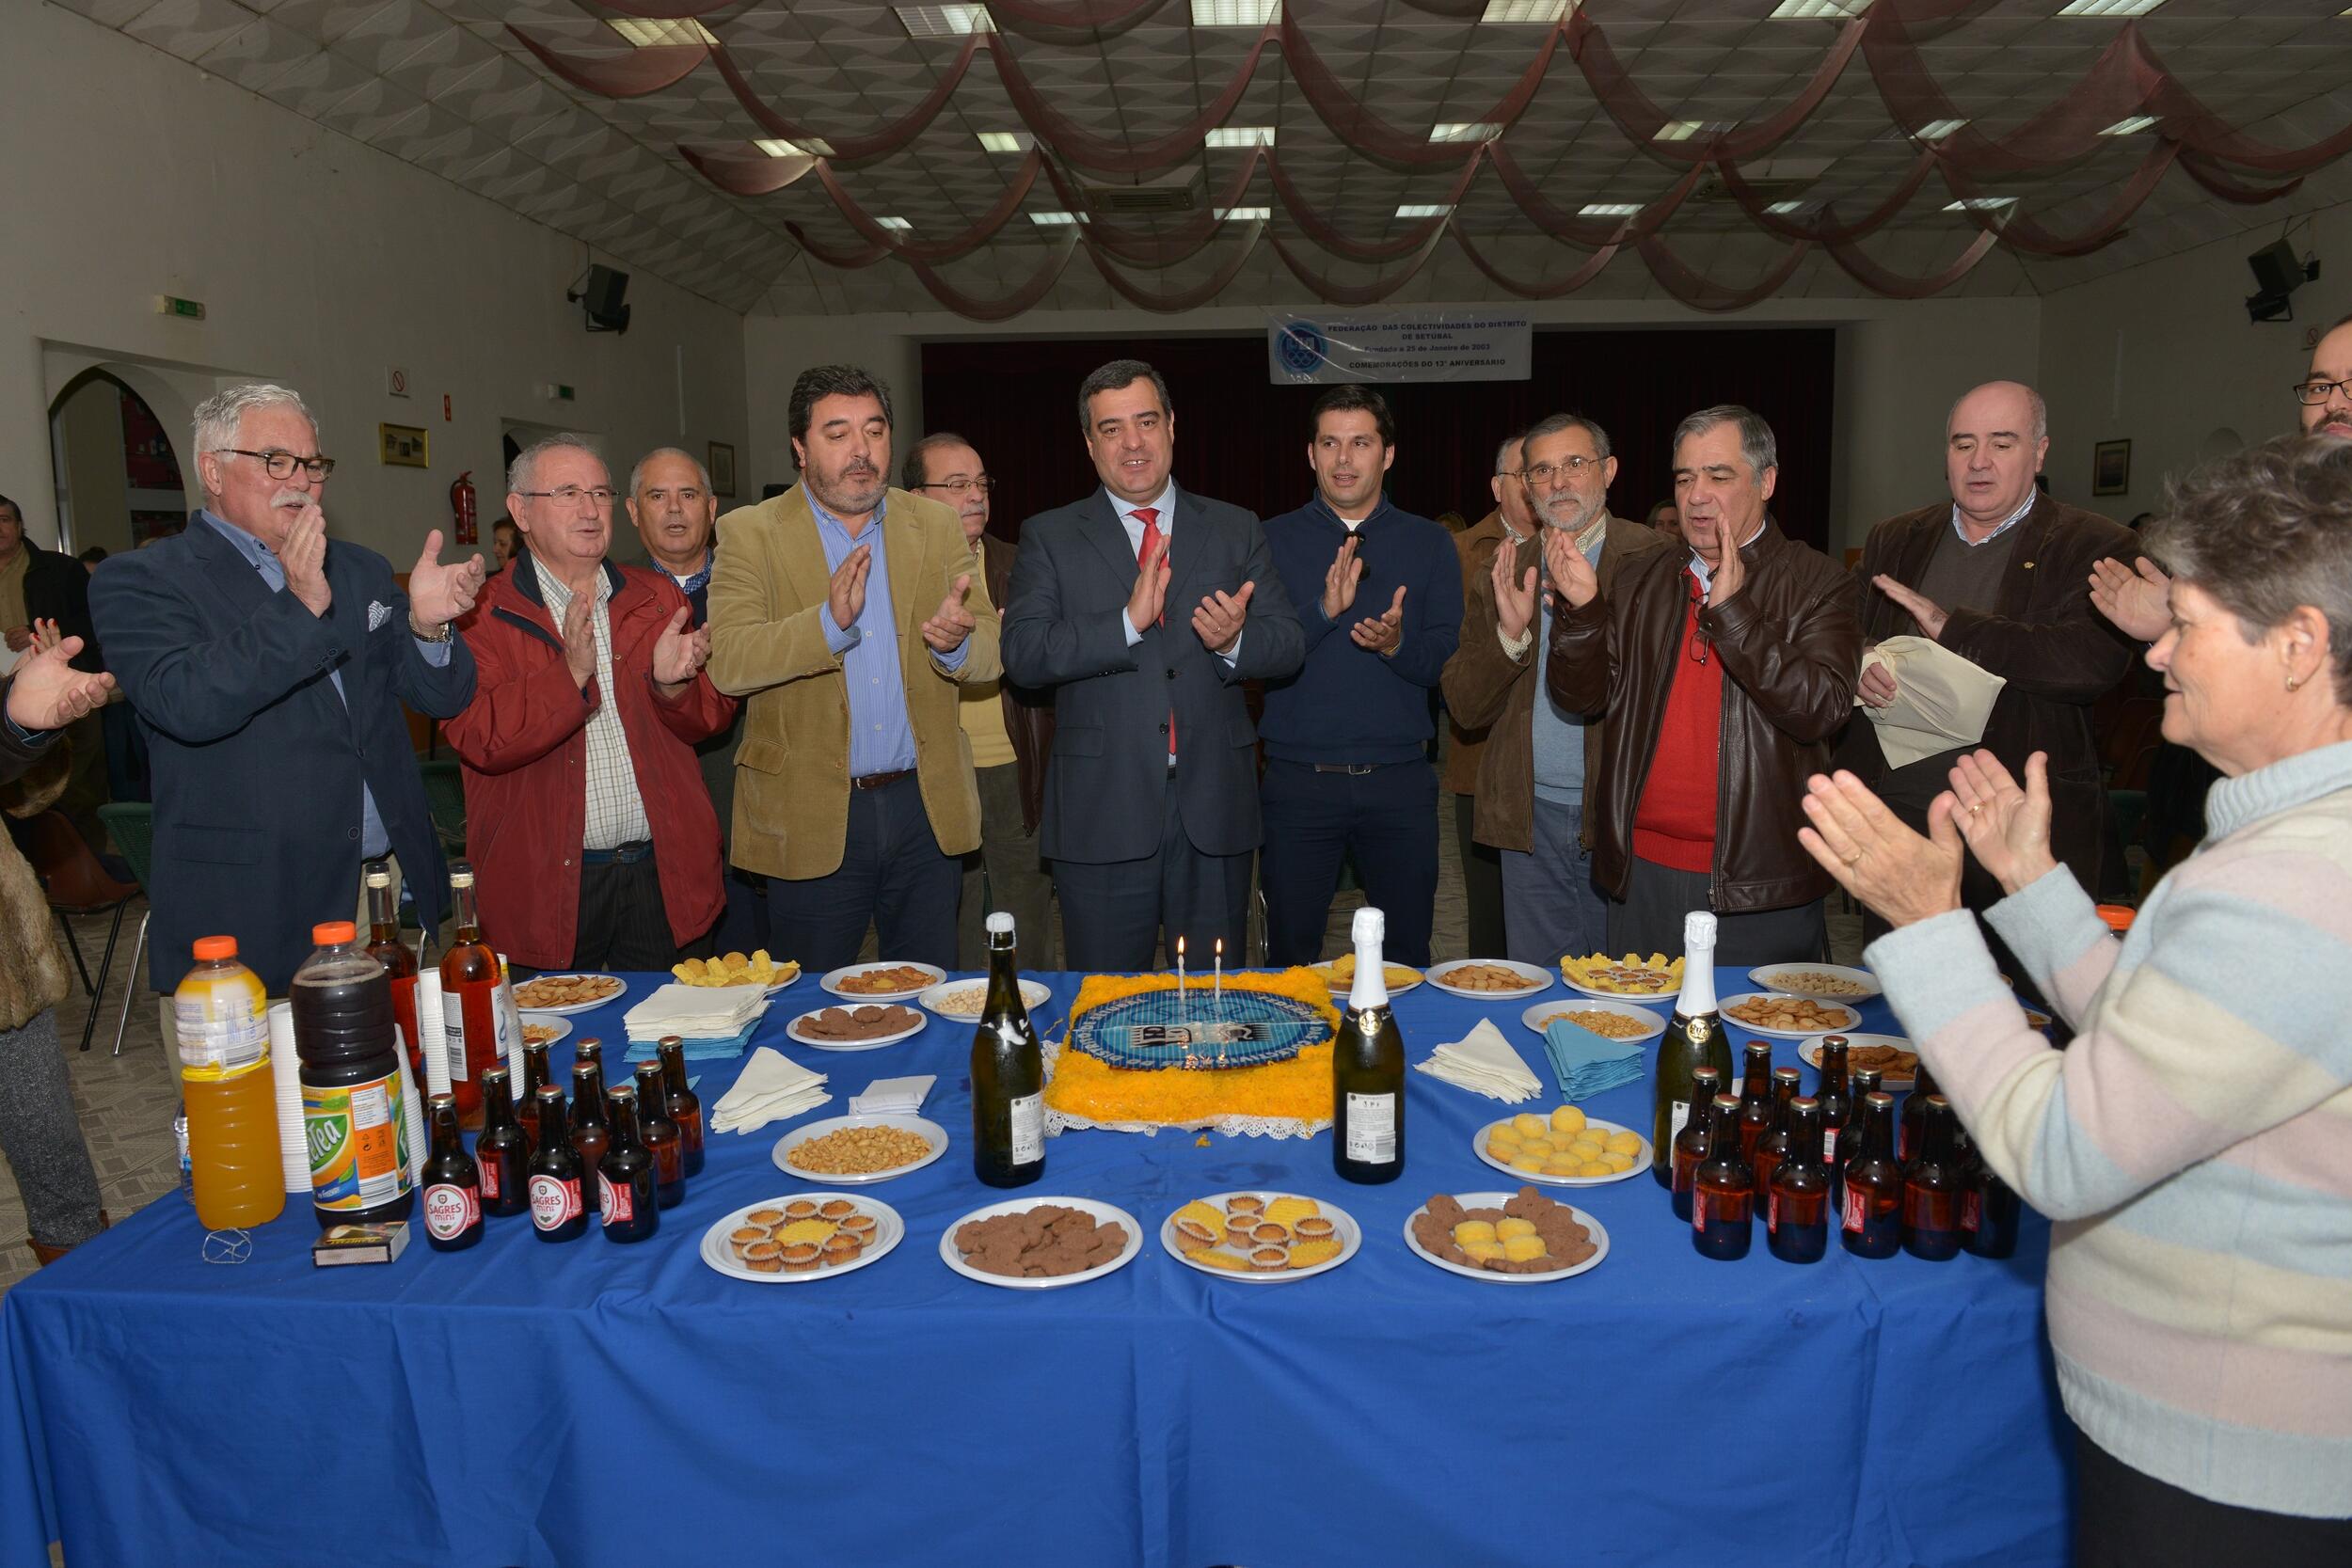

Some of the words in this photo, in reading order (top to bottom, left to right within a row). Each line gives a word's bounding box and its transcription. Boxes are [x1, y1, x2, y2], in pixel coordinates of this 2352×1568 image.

[1327, 324, 1377, 333] FEDERAÇÃO
[1401, 322, 1471, 331] COLECTIVIDADES
[1488, 320, 1527, 328] DISTRITO
[1349, 360, 1419, 369] COMEMORAÇÕES
[532, 1195, 561, 1206] SAGRES
[428, 1202, 462, 1214] SAGRES
